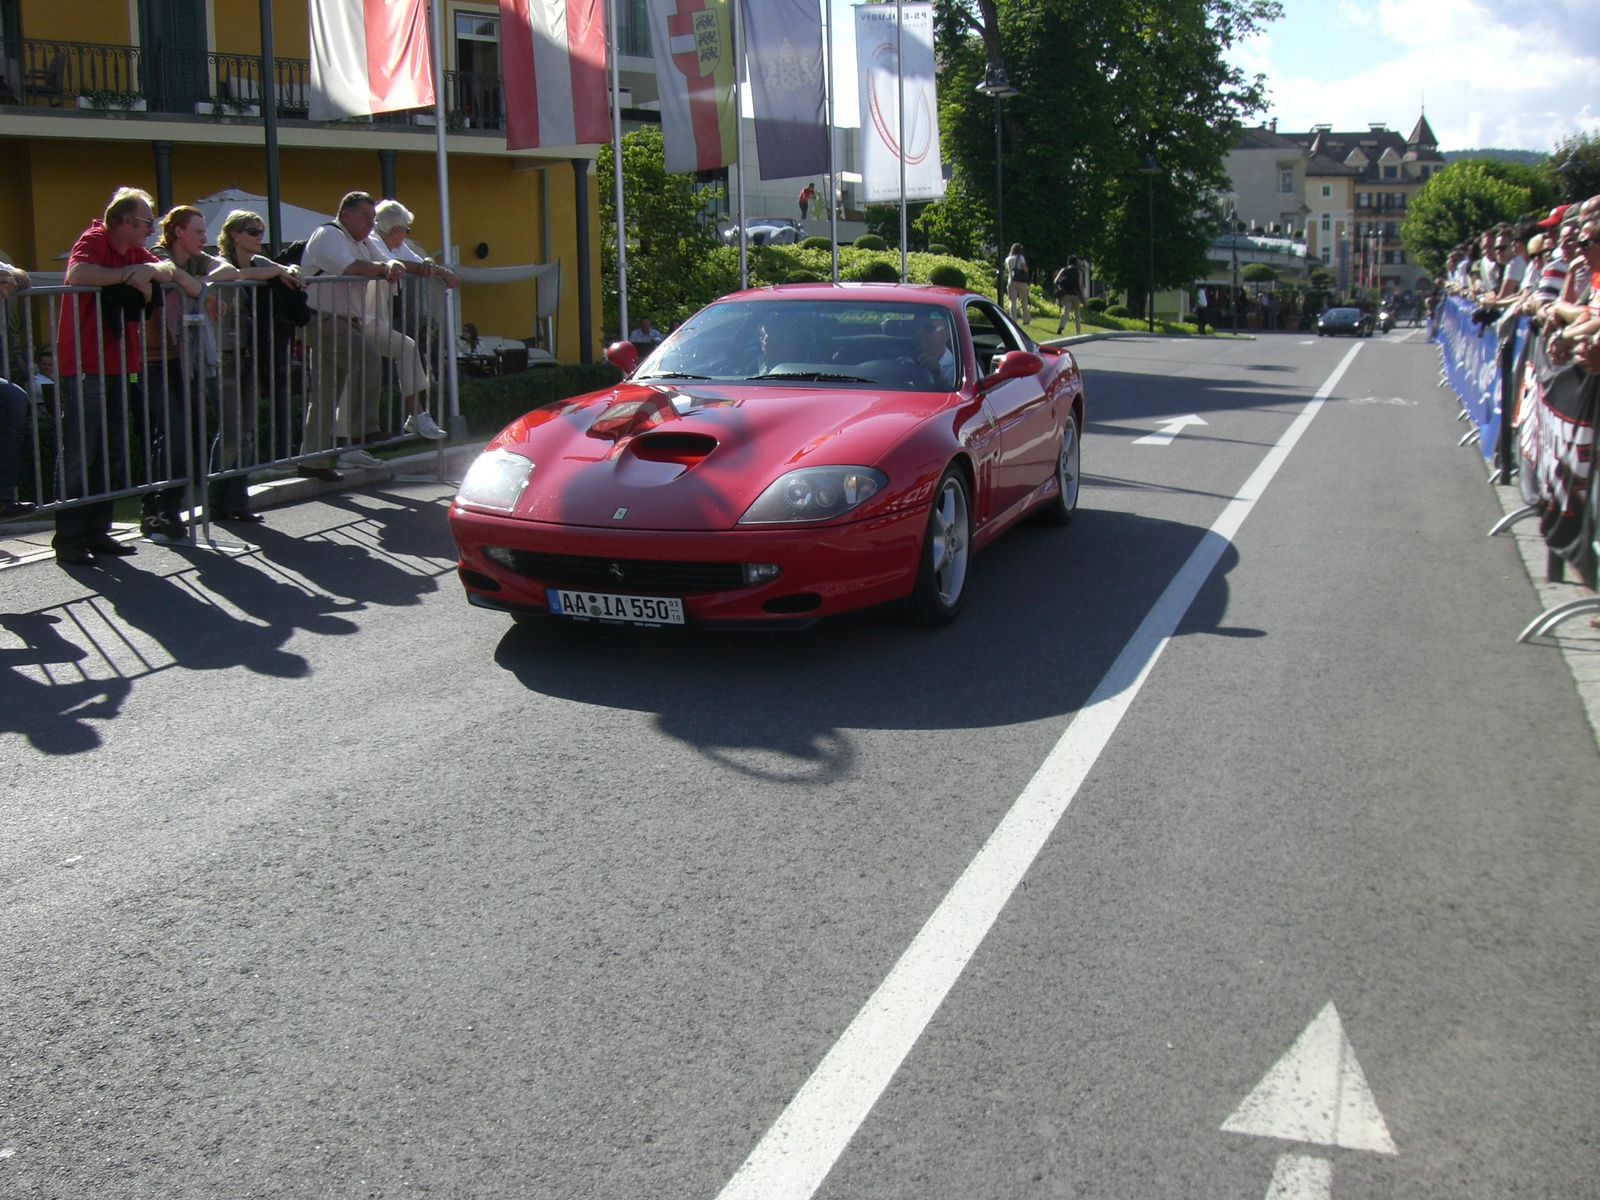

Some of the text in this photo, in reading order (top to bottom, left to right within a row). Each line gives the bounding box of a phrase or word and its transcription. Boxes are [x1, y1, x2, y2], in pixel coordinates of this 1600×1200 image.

[563, 593, 669, 619] AA IA 550
